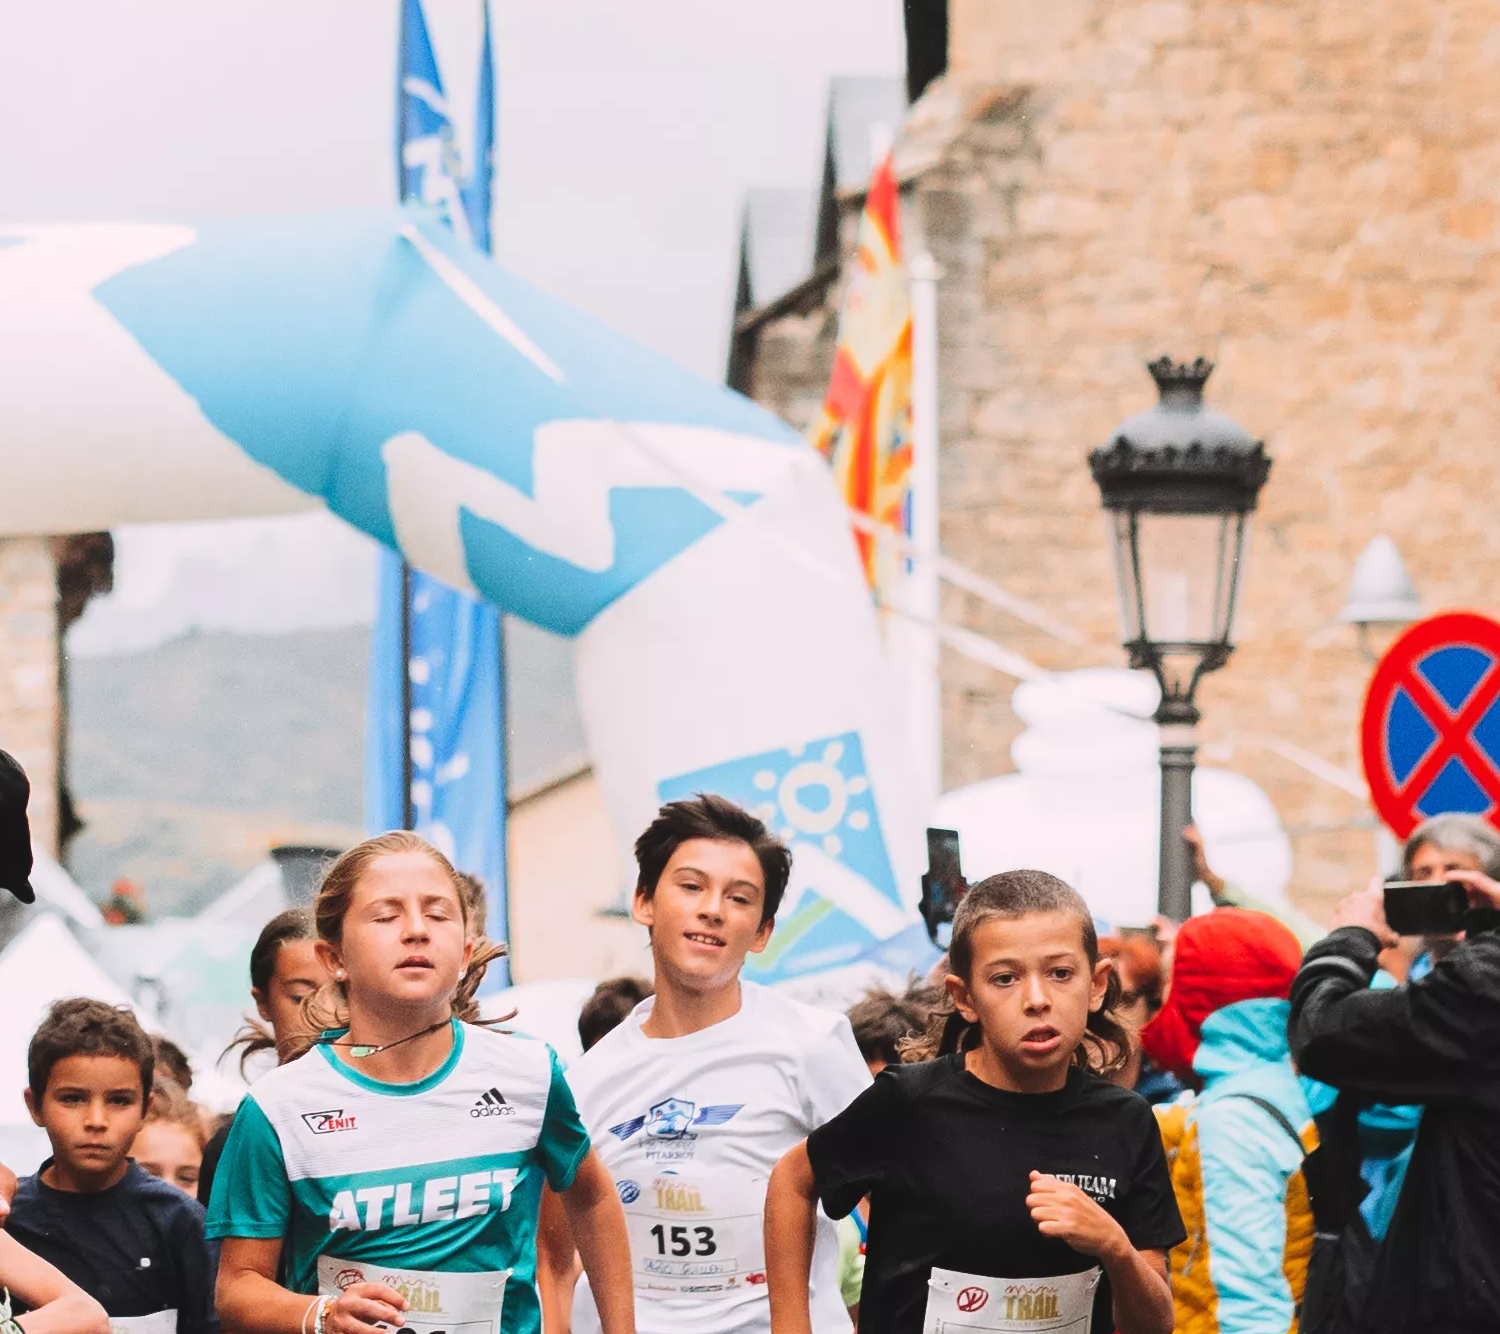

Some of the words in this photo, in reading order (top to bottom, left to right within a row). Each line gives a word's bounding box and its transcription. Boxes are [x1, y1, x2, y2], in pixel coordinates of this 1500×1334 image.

[311, 1113, 357, 1131] ZENIT
[470, 1105, 516, 1119] adidas
[655, 1187, 706, 1211] TRAIL
[1078, 1175, 1117, 1199] TEAM
[650, 1224, 717, 1257] 153
[1004, 1292, 1060, 1320] TRAIL
